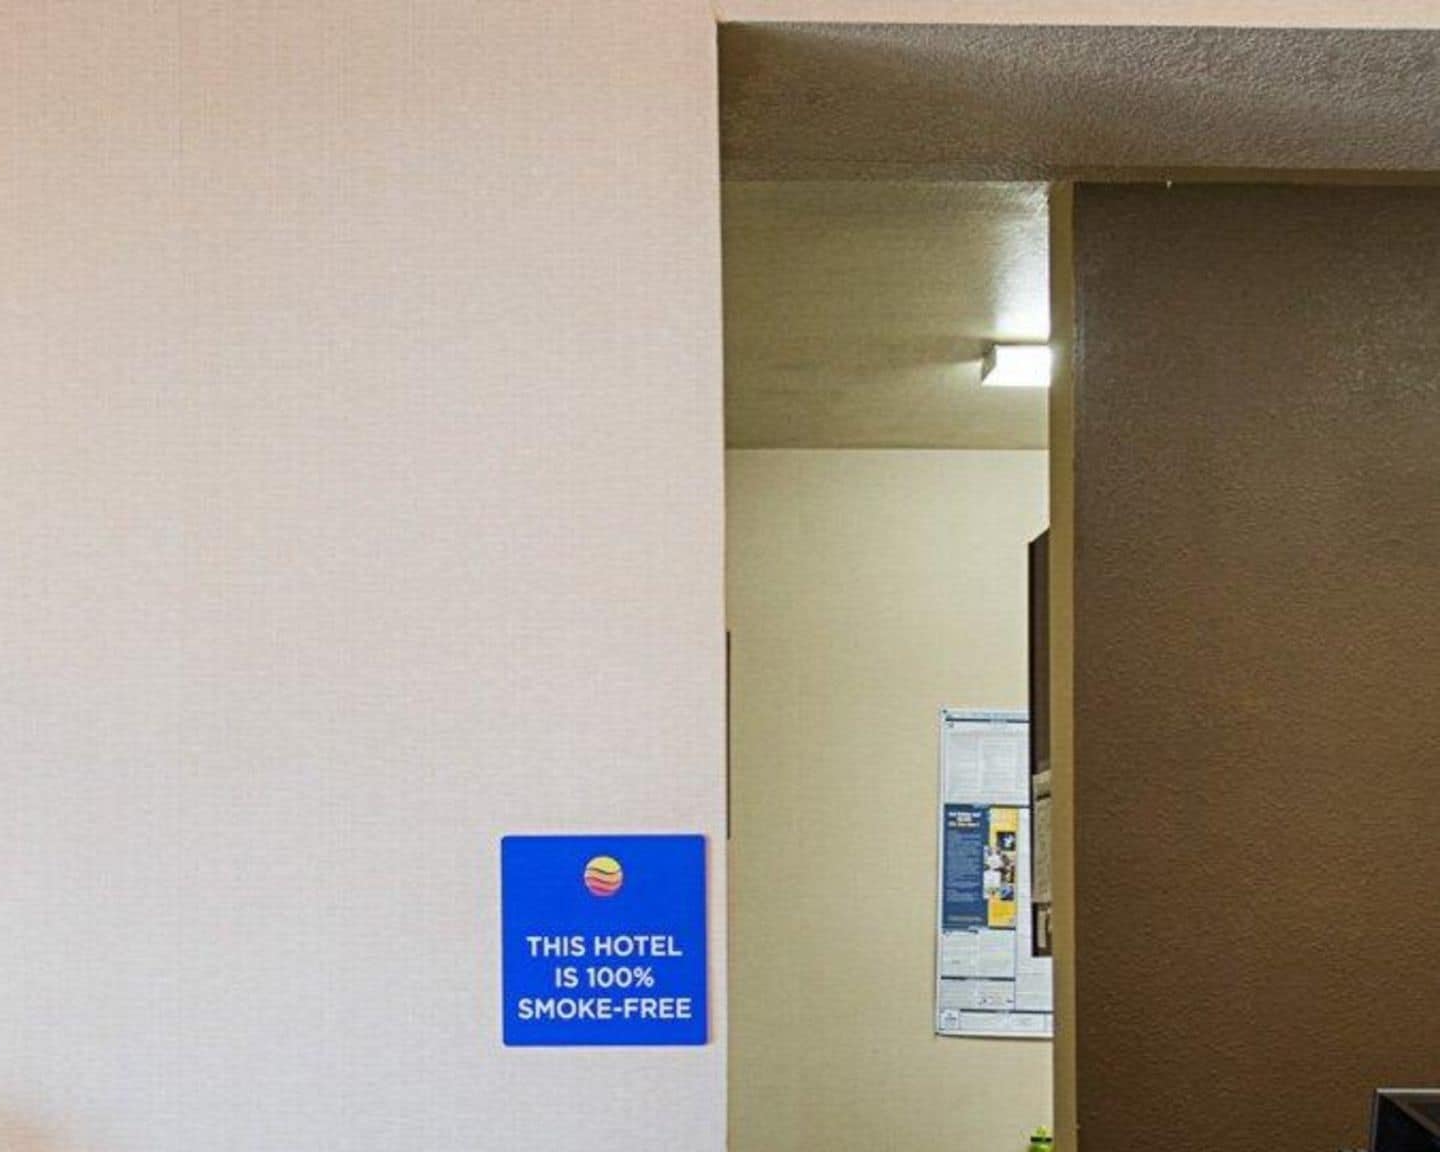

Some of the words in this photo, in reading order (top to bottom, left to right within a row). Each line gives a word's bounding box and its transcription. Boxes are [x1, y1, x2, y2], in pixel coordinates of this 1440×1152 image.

[526, 936, 586, 957] THIS
[594, 936, 683, 957] HOTEL
[555, 967, 579, 988] IS
[587, 966, 655, 988] 100%
[518, 997, 692, 1019] SMOKE-FREE
